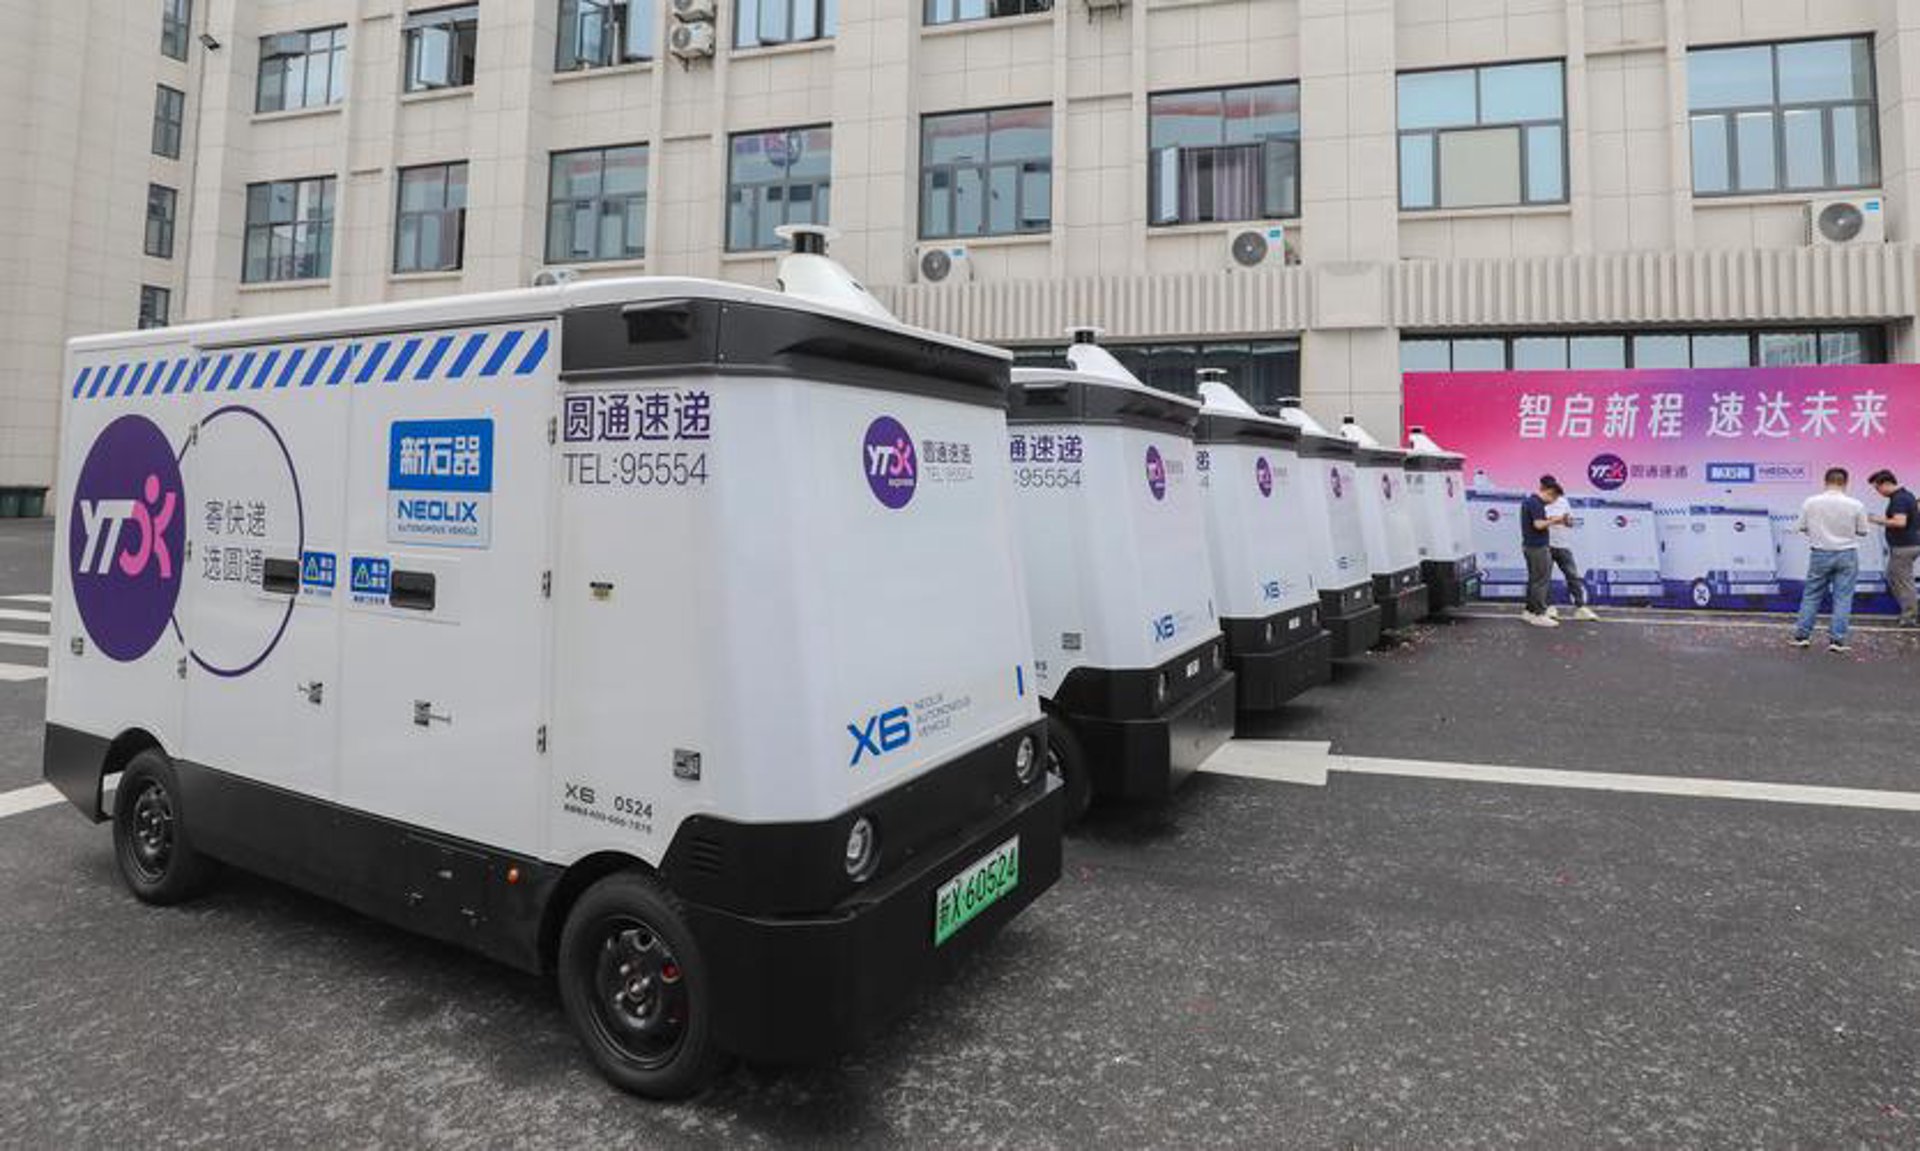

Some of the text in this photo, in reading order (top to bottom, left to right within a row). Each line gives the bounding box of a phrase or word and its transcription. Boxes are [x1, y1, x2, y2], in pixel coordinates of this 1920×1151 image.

[563, 392, 710, 442] 圆通速递
[1518, 389, 1887, 438] 智启新程 速达未来
[399, 436, 480, 475] 新石器
[563, 452, 710, 485] TEL:95554
[397, 500, 478, 523] NEOLIX
[1153, 615, 1175, 642] X6
[847, 706, 912, 767] X6
[564, 782, 596, 805] X6
[614, 795, 653, 819] 0524
